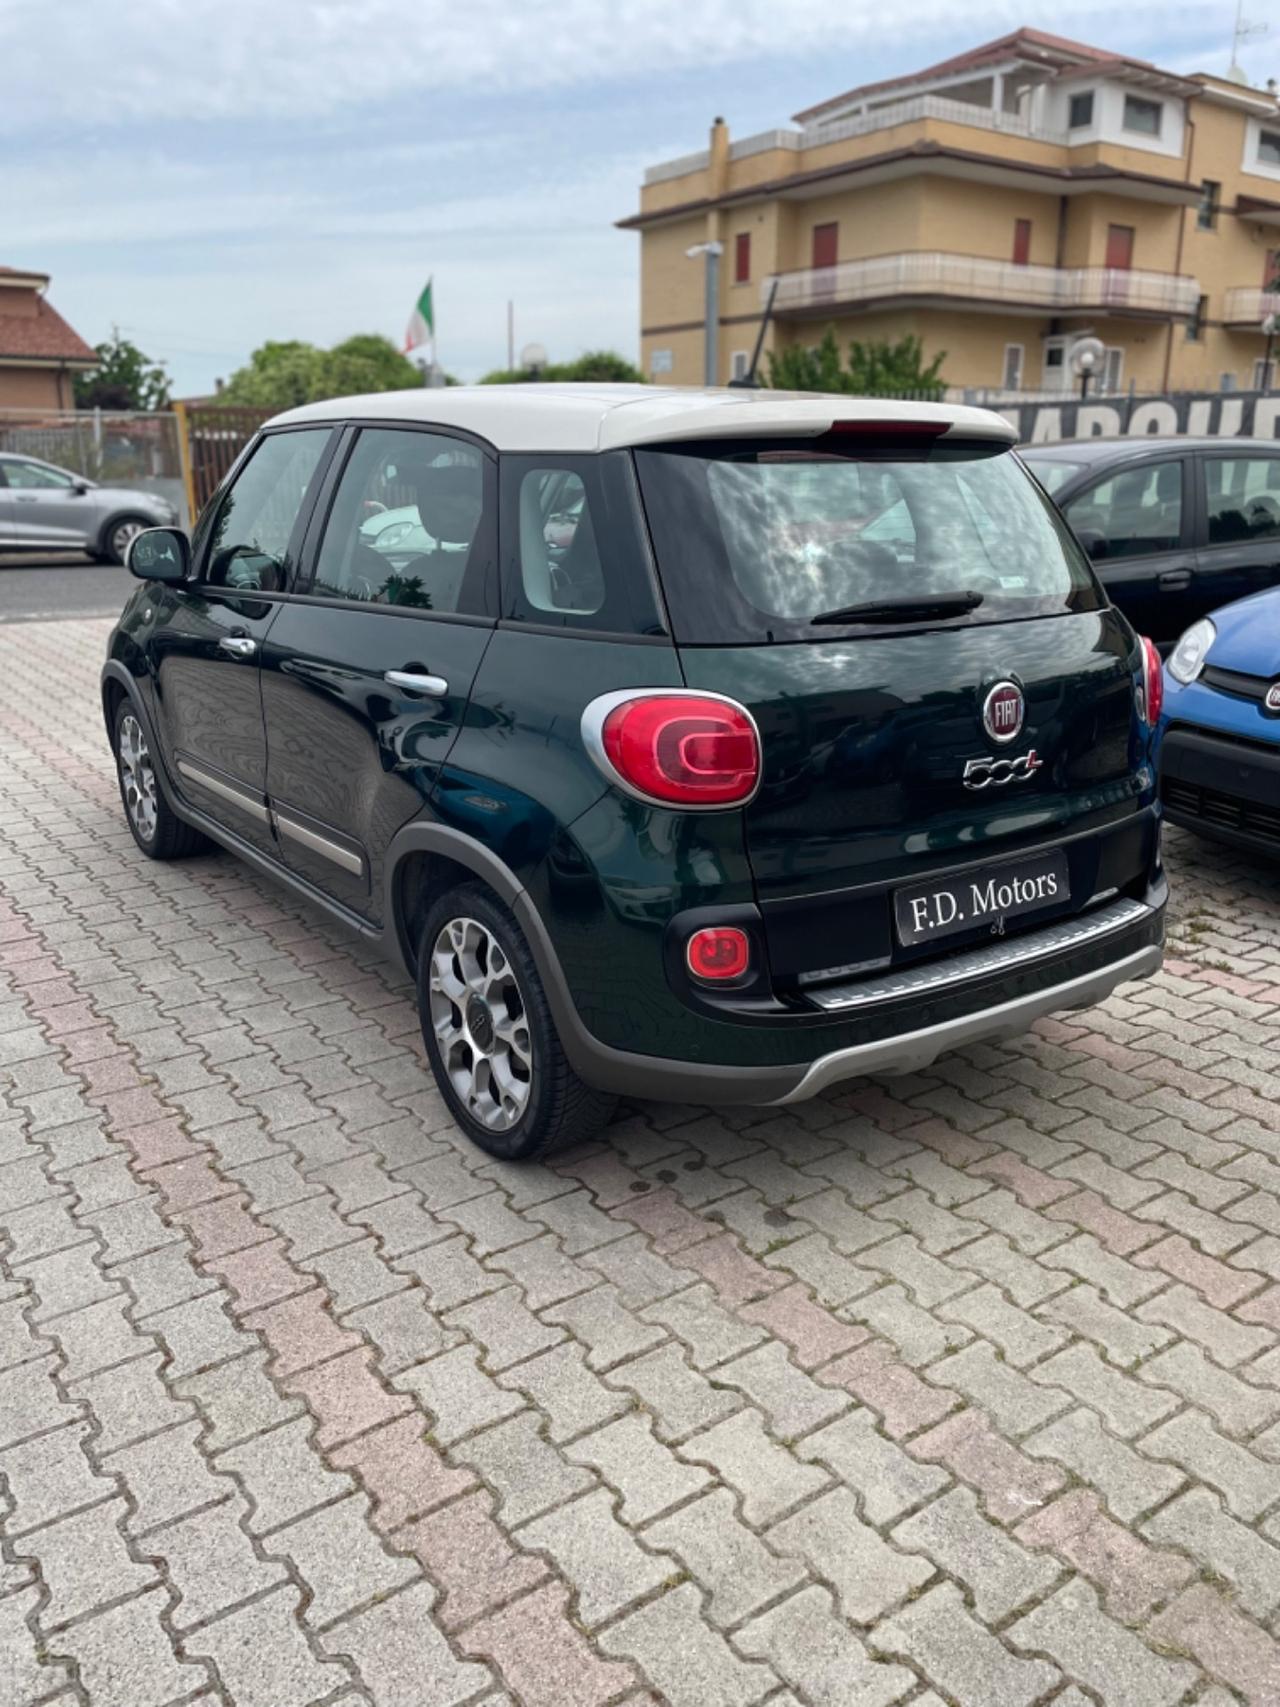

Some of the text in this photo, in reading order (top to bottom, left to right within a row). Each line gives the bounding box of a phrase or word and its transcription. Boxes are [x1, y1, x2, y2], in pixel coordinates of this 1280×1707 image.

[994, 698, 1018, 728] FIAT
[963, 750, 1043, 789] 500L
[909, 872, 1058, 933] F.D. Motors
